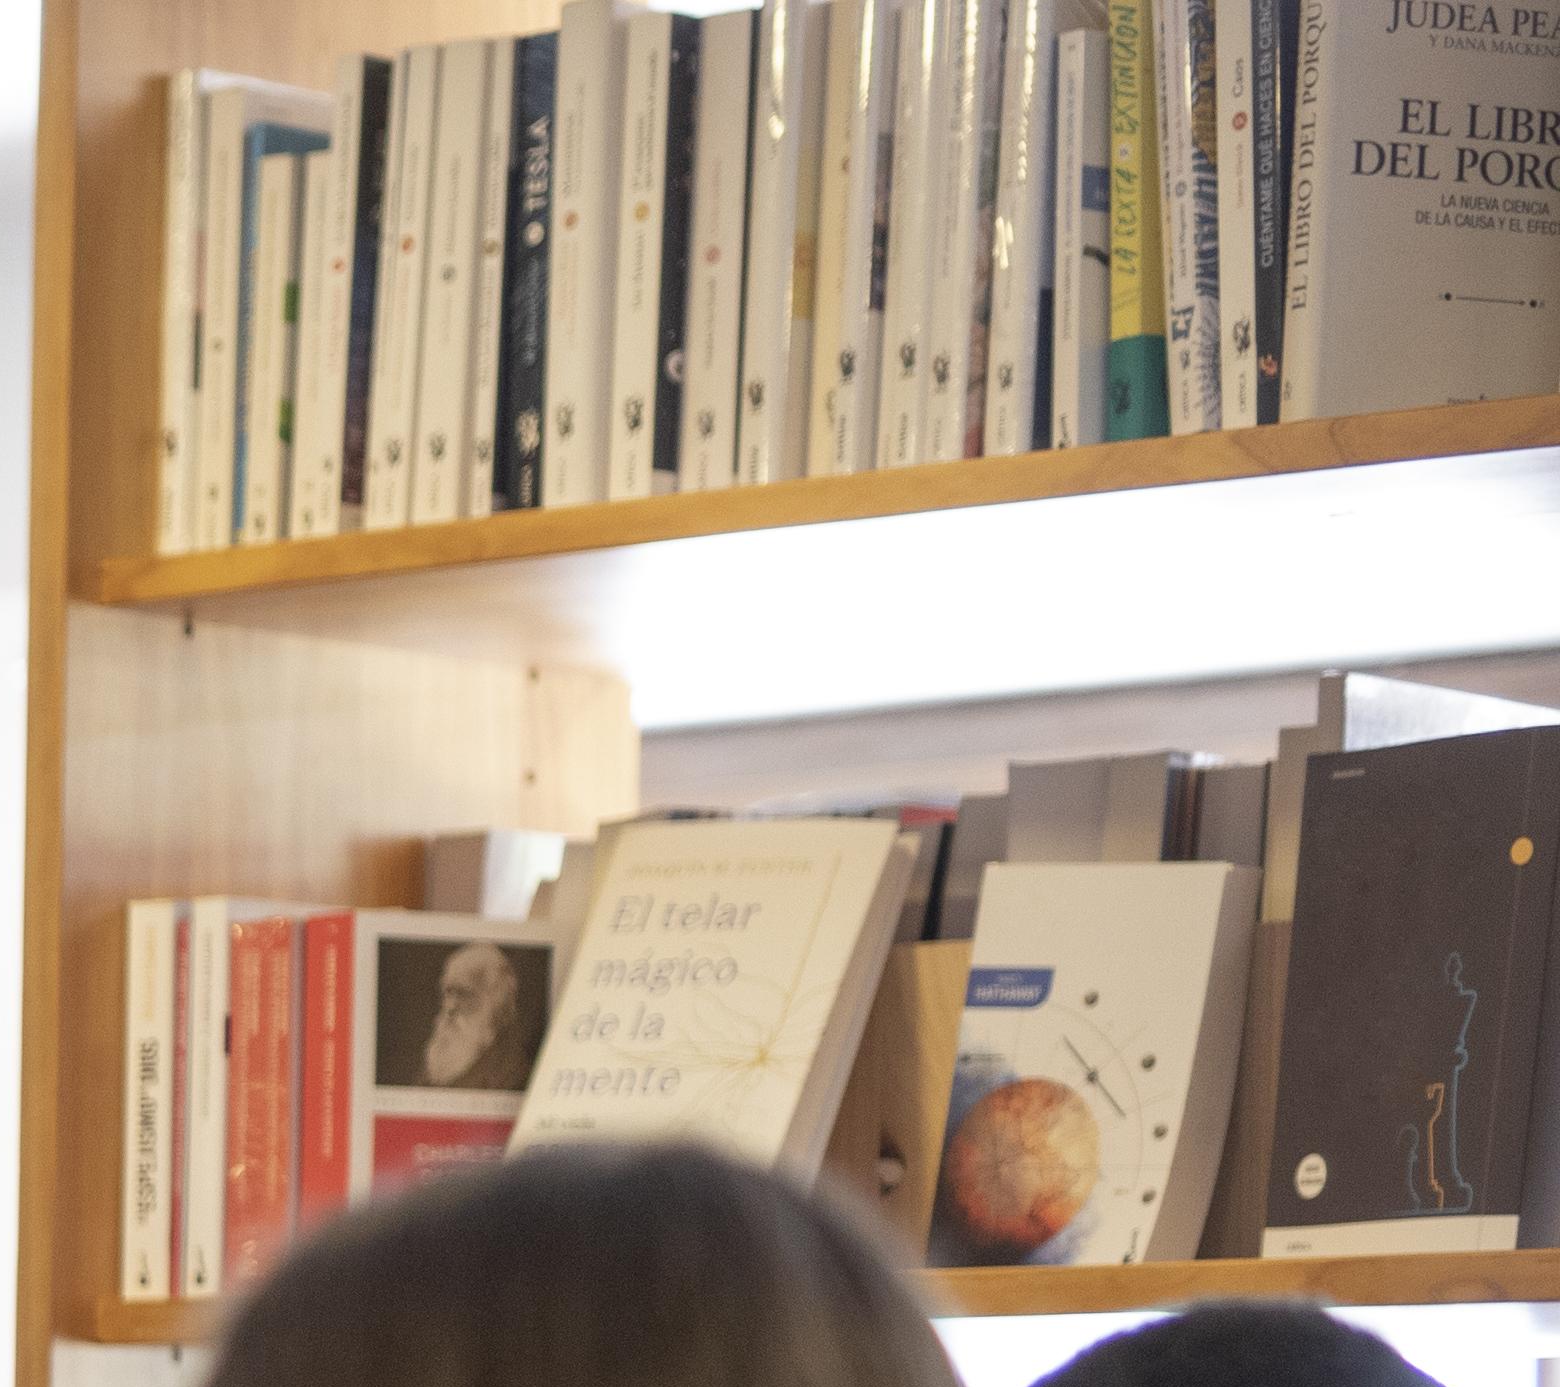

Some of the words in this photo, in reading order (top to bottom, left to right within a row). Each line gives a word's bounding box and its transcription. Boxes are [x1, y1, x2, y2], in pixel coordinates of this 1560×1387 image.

[1386, 0, 1500, 34] JUDEA
[1429, 35, 1441, 48] Y
[1443, 36, 1488, 52] DANA
[1231, 58, 1245, 99] Caos
[1259, 52, 1273, 77] EN
[1259, 78, 1274, 136] HACES
[1399, 98, 1451, 137] EL
[1258, 138, 1276, 174] QUÉ
[1296, 111, 1316, 168] DEL
[524, 116, 551, 215] TESLA
[1351, 139, 1440, 181] DEL
[1259, 177, 1276, 268] CUÉNTAME
[1291, 178, 1315, 269] LIBRO
[1415, 210, 1432, 226] DE
[1433, 212, 1451, 228] LA
[1454, 212, 1495, 230] CAUSA
[1495, 214, 1506, 230] Y
[1508, 217, 1524, 234] EL
[1440, 193, 1457, 209] LA
[1460, 194, 1500, 212] NUEVA
[1502, 198, 1550, 216] CIENCIA
[1290, 274, 1310, 311] EL
[610, 894, 654, 932] El
[661, 892, 761, 931] telar
[588, 947, 738, 996] mágico
[570, 1003, 621, 1043] de
[630, 1001, 666, 1040] la
[550, 1066, 682, 1096] mente
